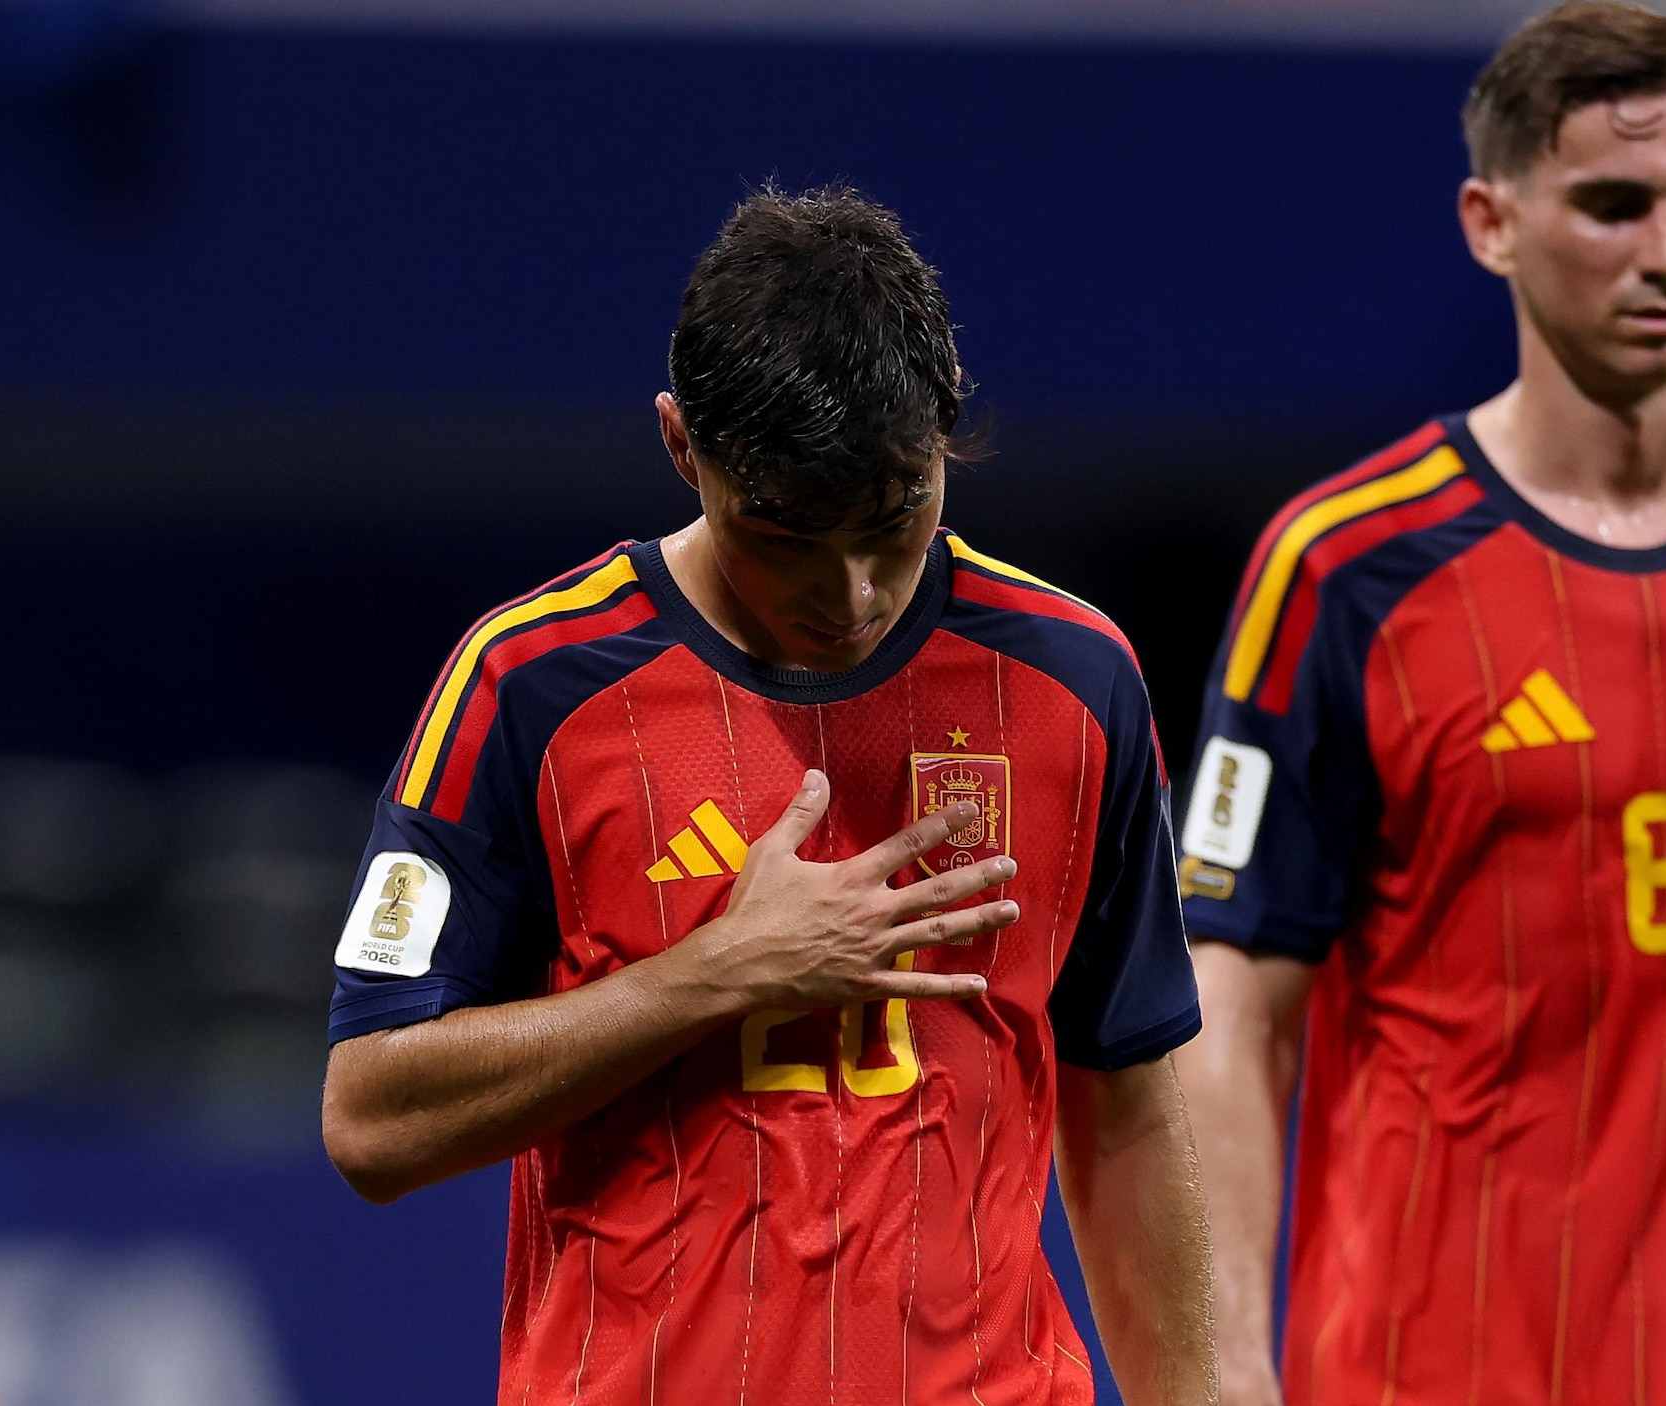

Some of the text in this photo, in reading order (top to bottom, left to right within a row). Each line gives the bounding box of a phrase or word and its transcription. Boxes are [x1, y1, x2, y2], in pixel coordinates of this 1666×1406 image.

[377, 922, 397, 934] FIFA
[362, 941, 405, 953] WORLD CUP
[357, 949, 402, 966] 2026
